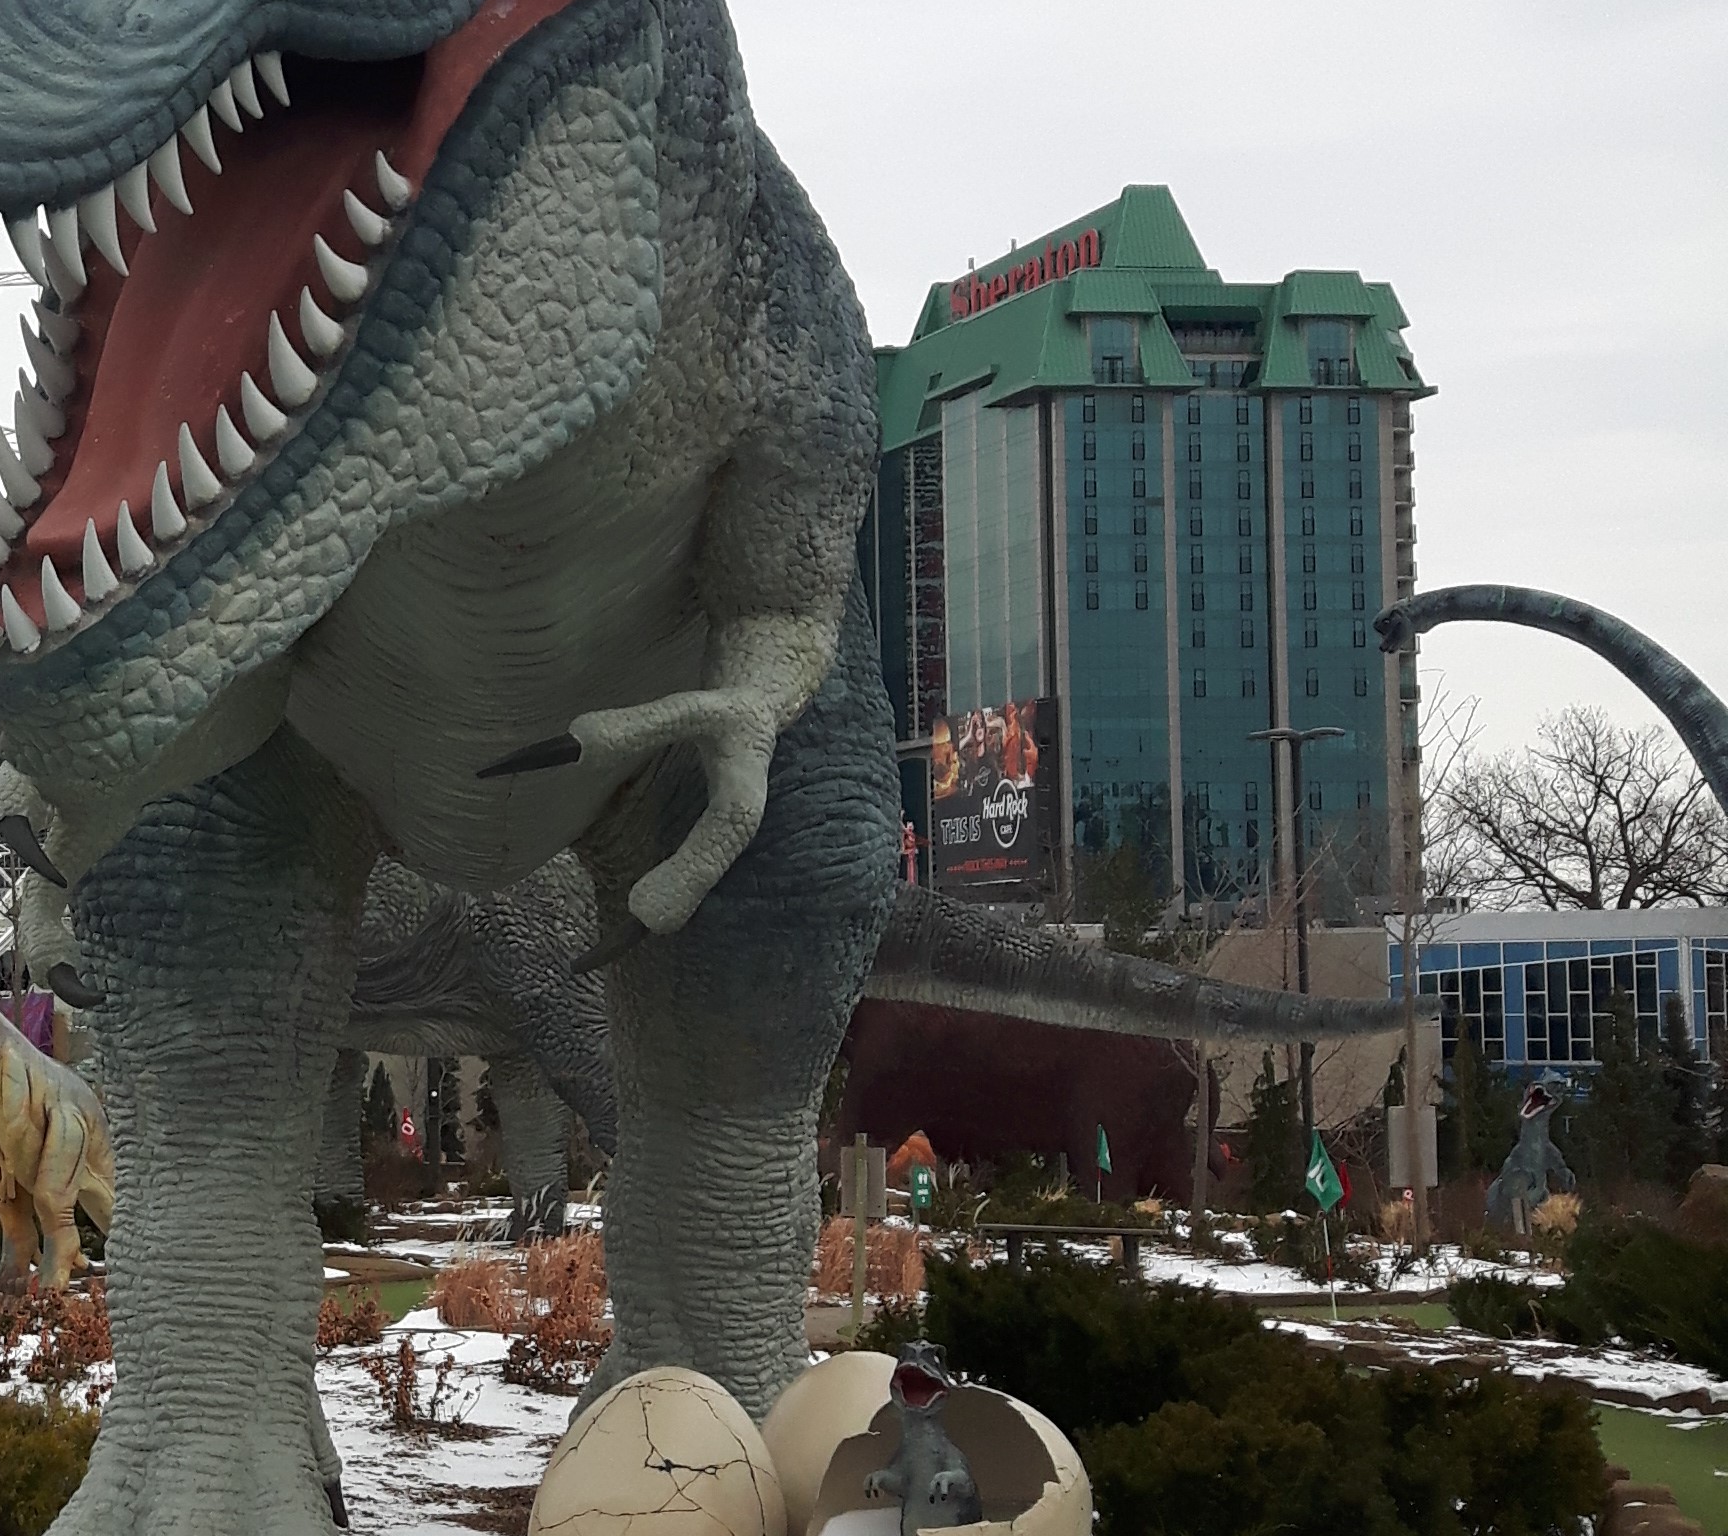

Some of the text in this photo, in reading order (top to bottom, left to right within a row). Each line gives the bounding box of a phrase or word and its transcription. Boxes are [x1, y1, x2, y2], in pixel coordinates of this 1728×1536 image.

[950, 228, 1100, 324] Sheraton
[983, 791, 1028, 821] Hard Rock
[940, 815, 981, 845] THIS IS
